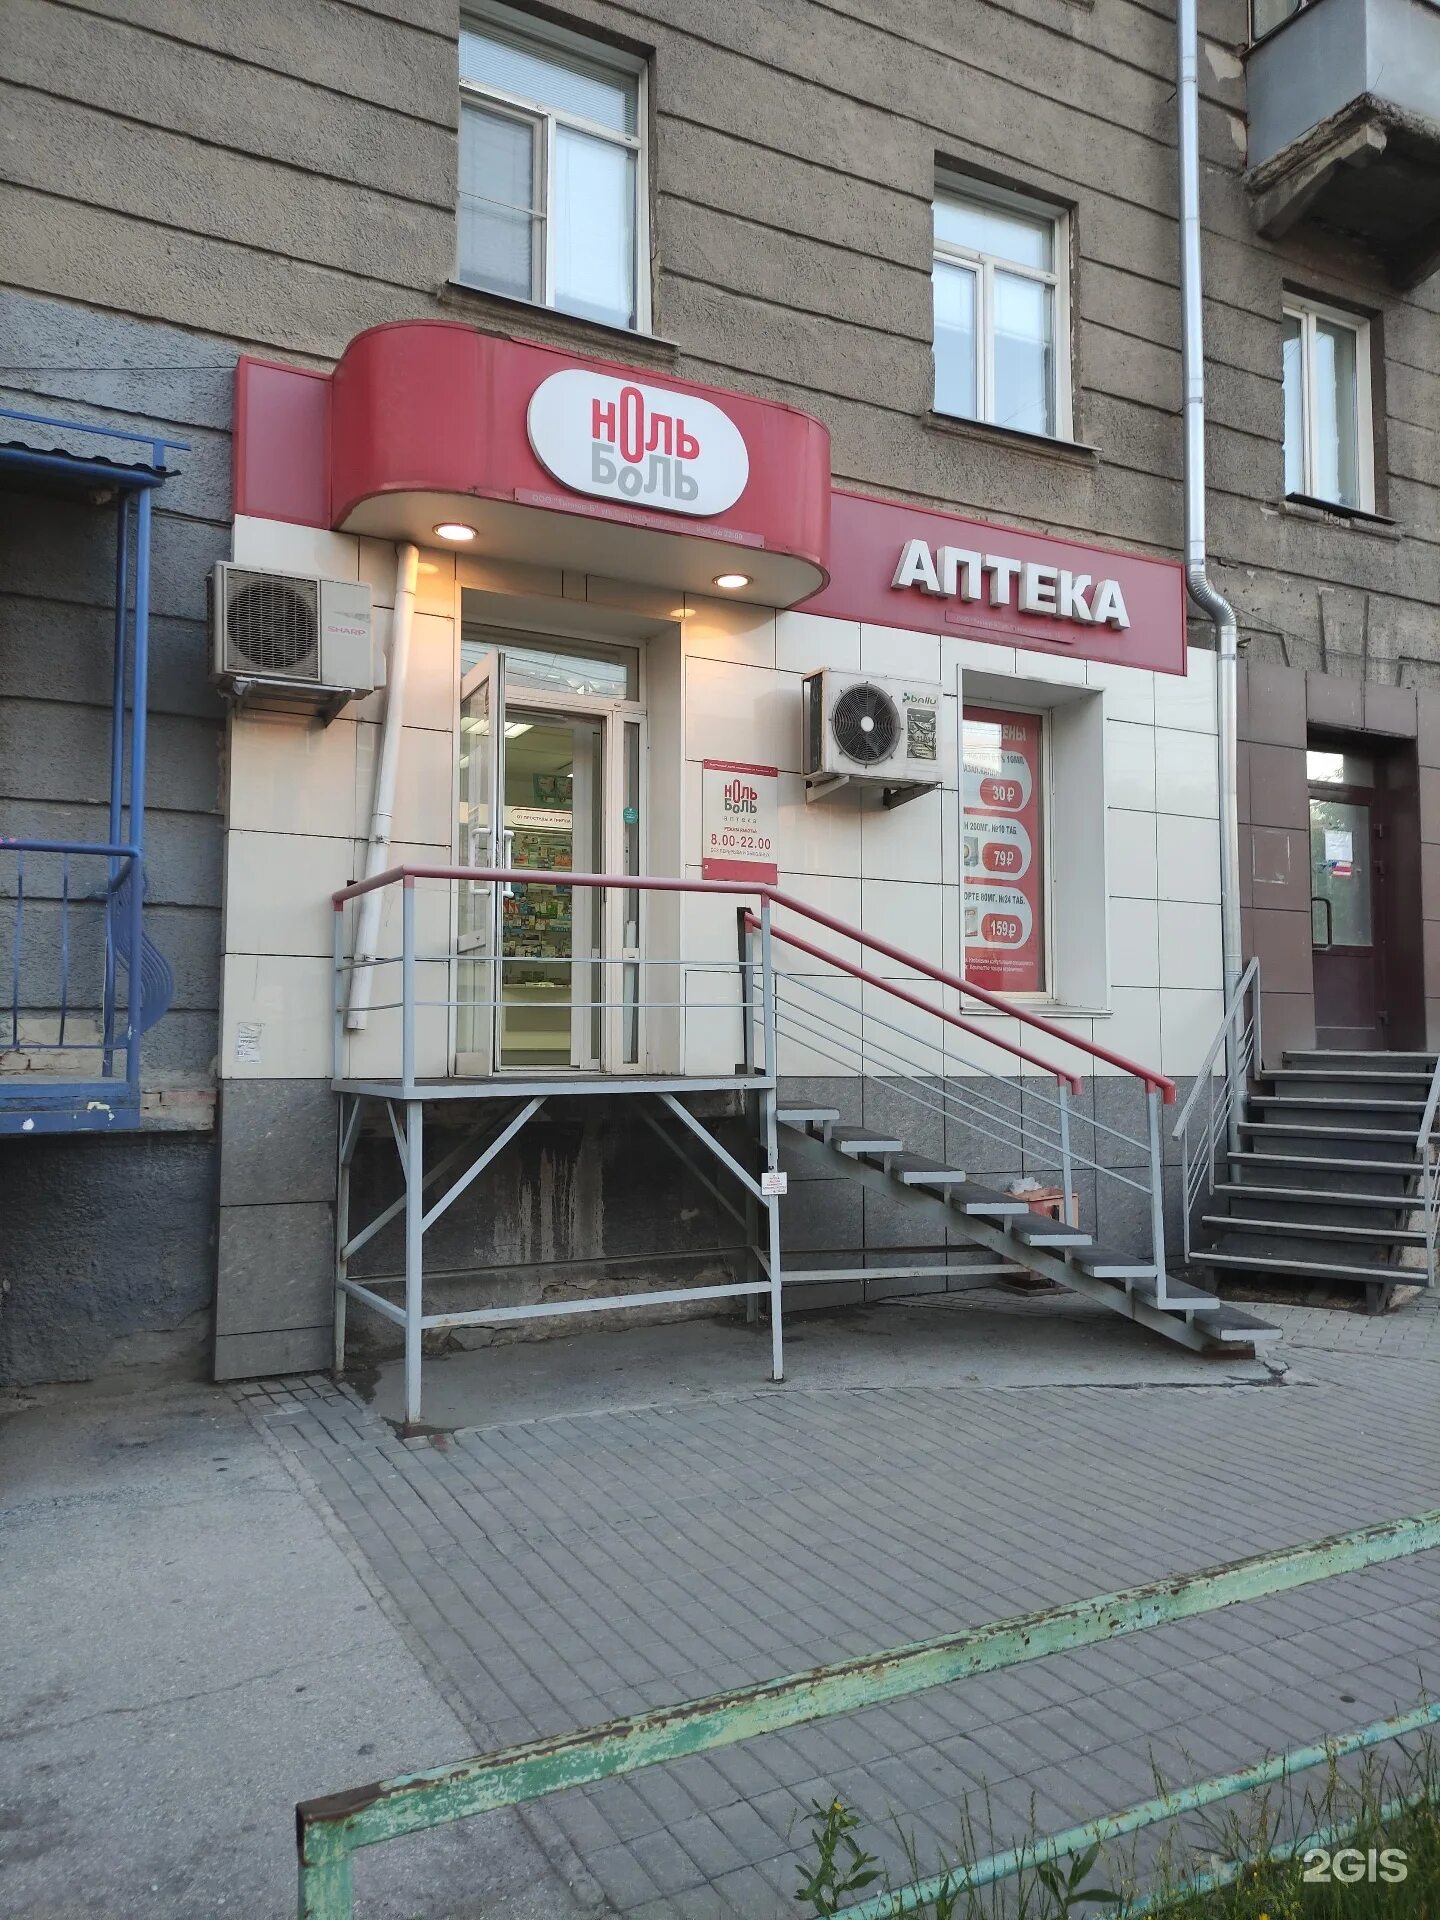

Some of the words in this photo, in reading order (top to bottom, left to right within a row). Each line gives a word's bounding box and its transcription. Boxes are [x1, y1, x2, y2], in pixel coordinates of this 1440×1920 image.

[591, 386, 700, 463] НОЛЬ
[891, 539, 1131, 631] АПТЕКА
[327, 625, 366, 636] SHARP
[711, 833, 771, 850] 8.00-22.00
